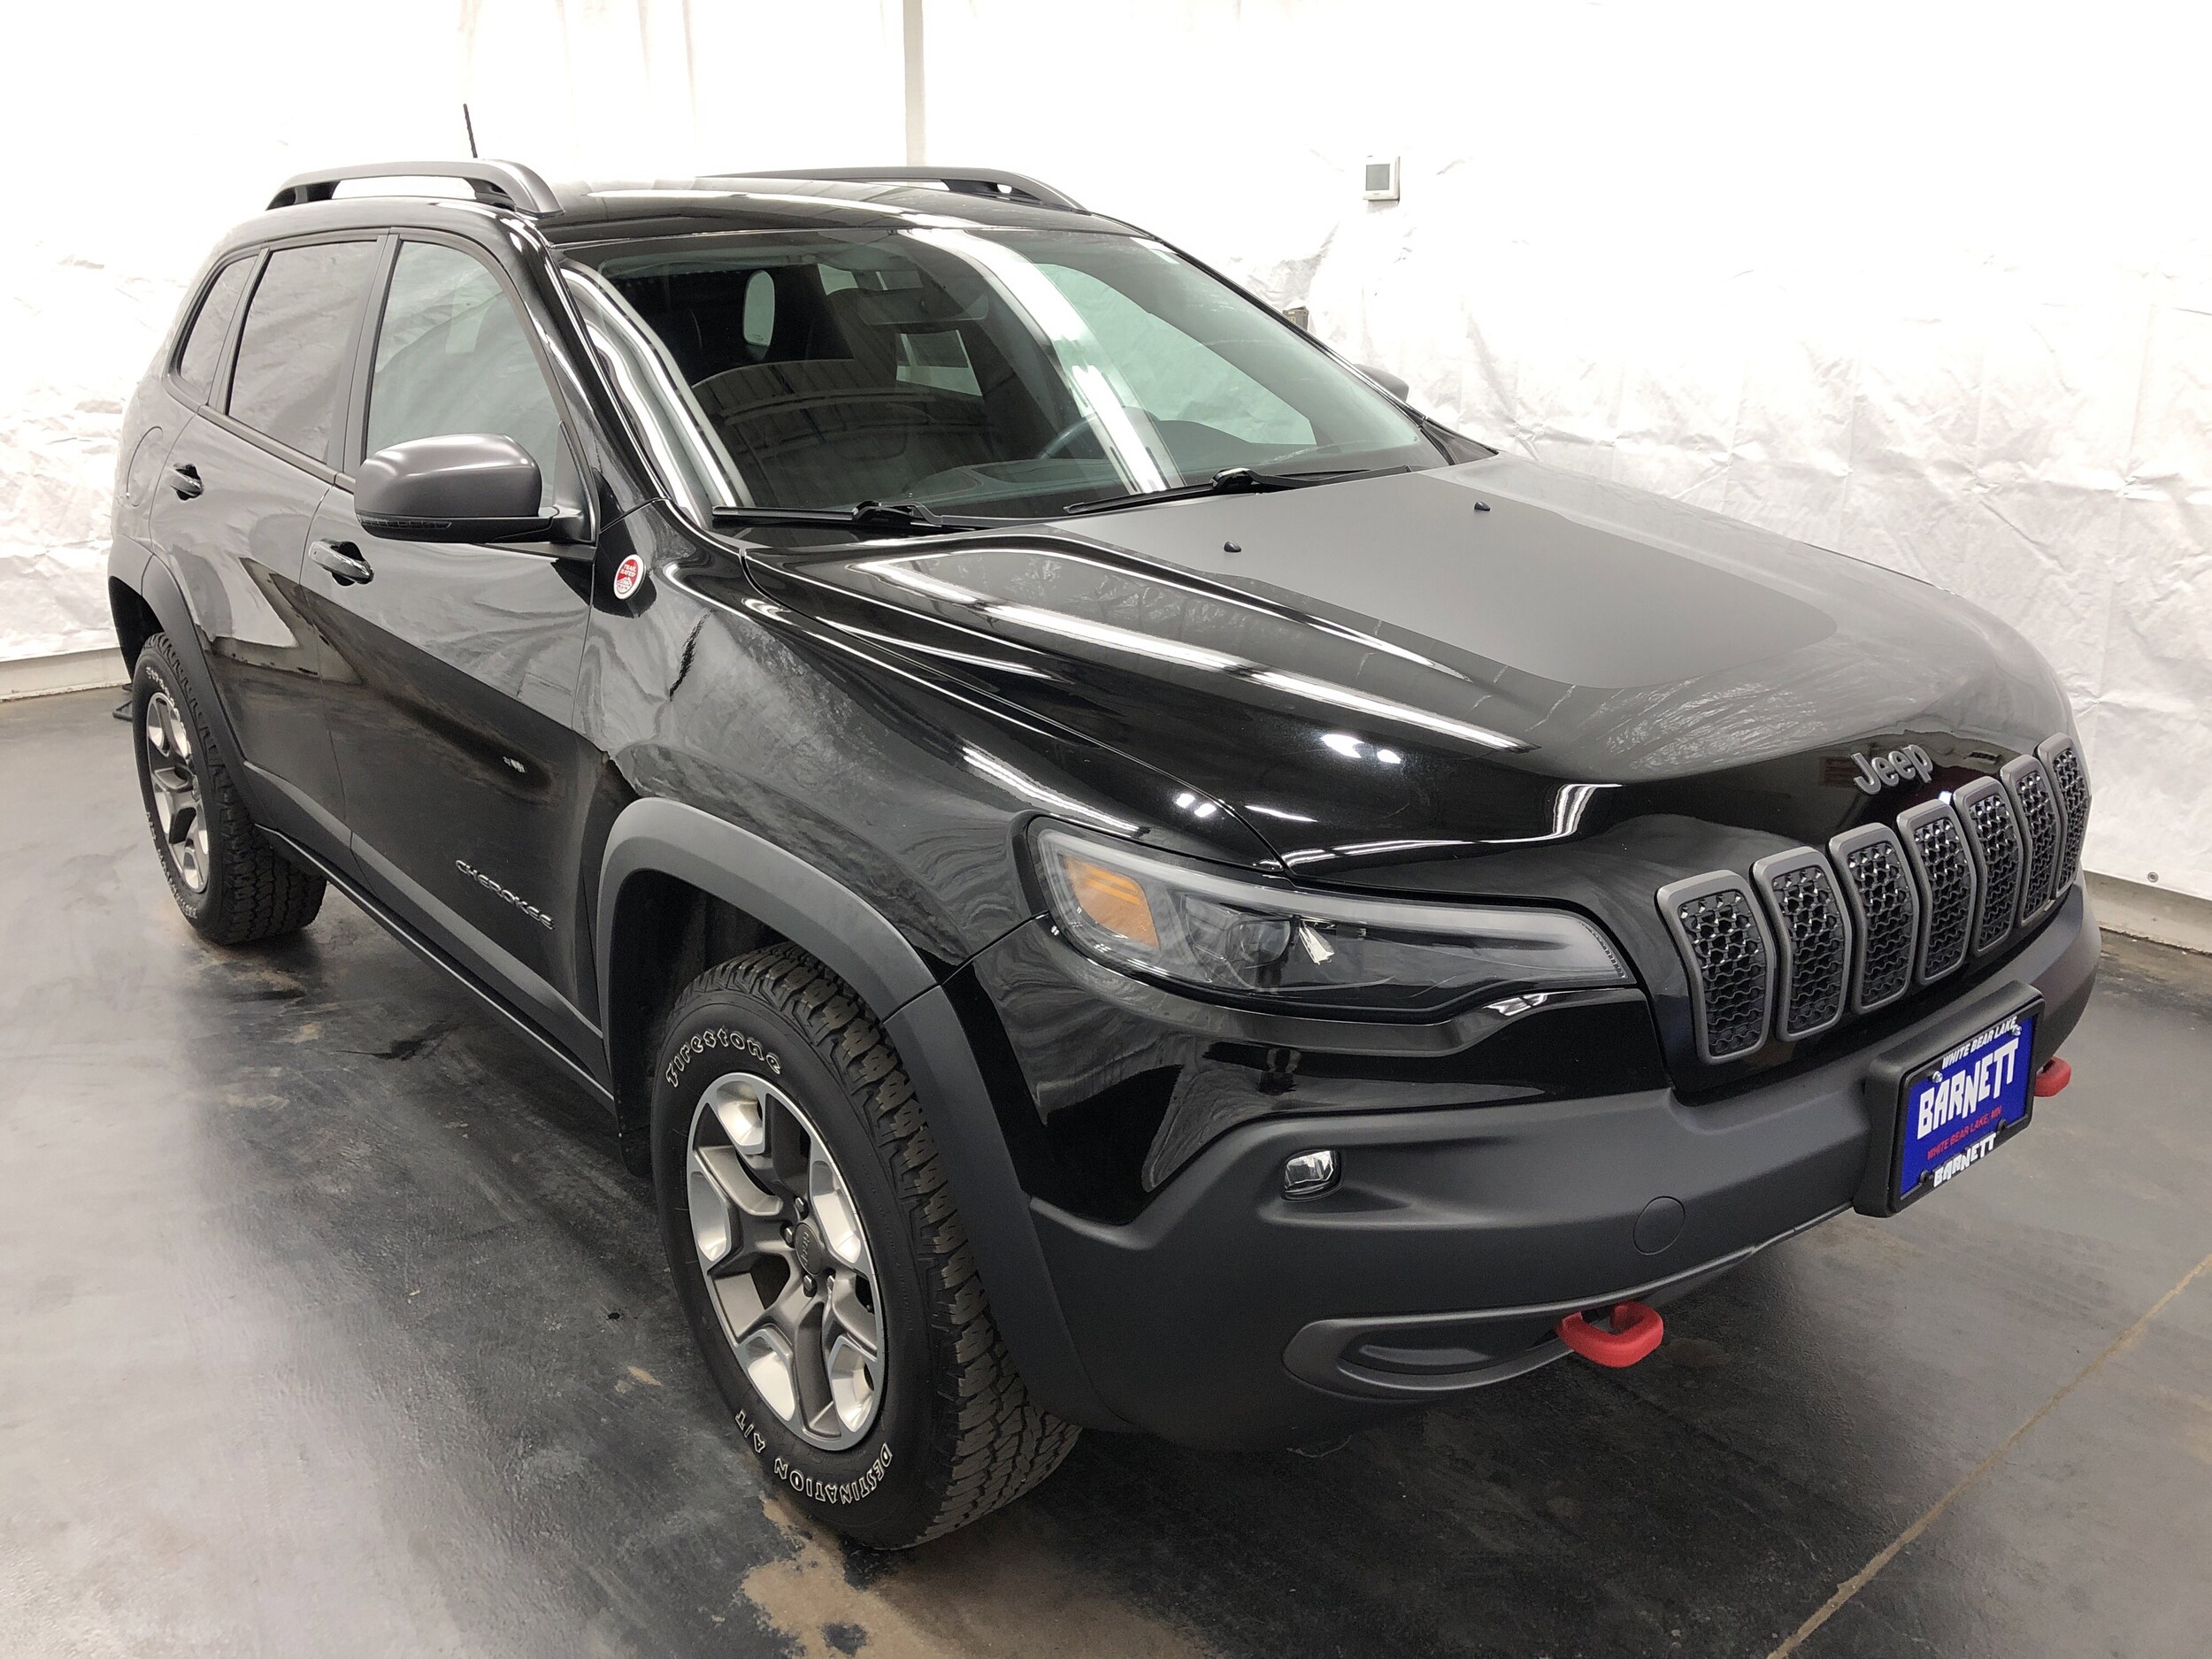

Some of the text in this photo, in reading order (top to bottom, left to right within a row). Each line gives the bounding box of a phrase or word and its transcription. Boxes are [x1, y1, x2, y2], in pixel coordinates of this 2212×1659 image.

[1850, 744, 1933, 795] Jeep
[665, 1027, 780, 1087] Firestone
[1941, 1016, 2017, 1070] WHITE BEAR LAKE
[1917, 1037, 2019, 1140] BARNETT
[1933, 1133, 1996, 1187] BARNETT
[1950, 1125, 1969, 1146] BEAR
[734, 1409, 893, 1504] DESTINATION A/T
